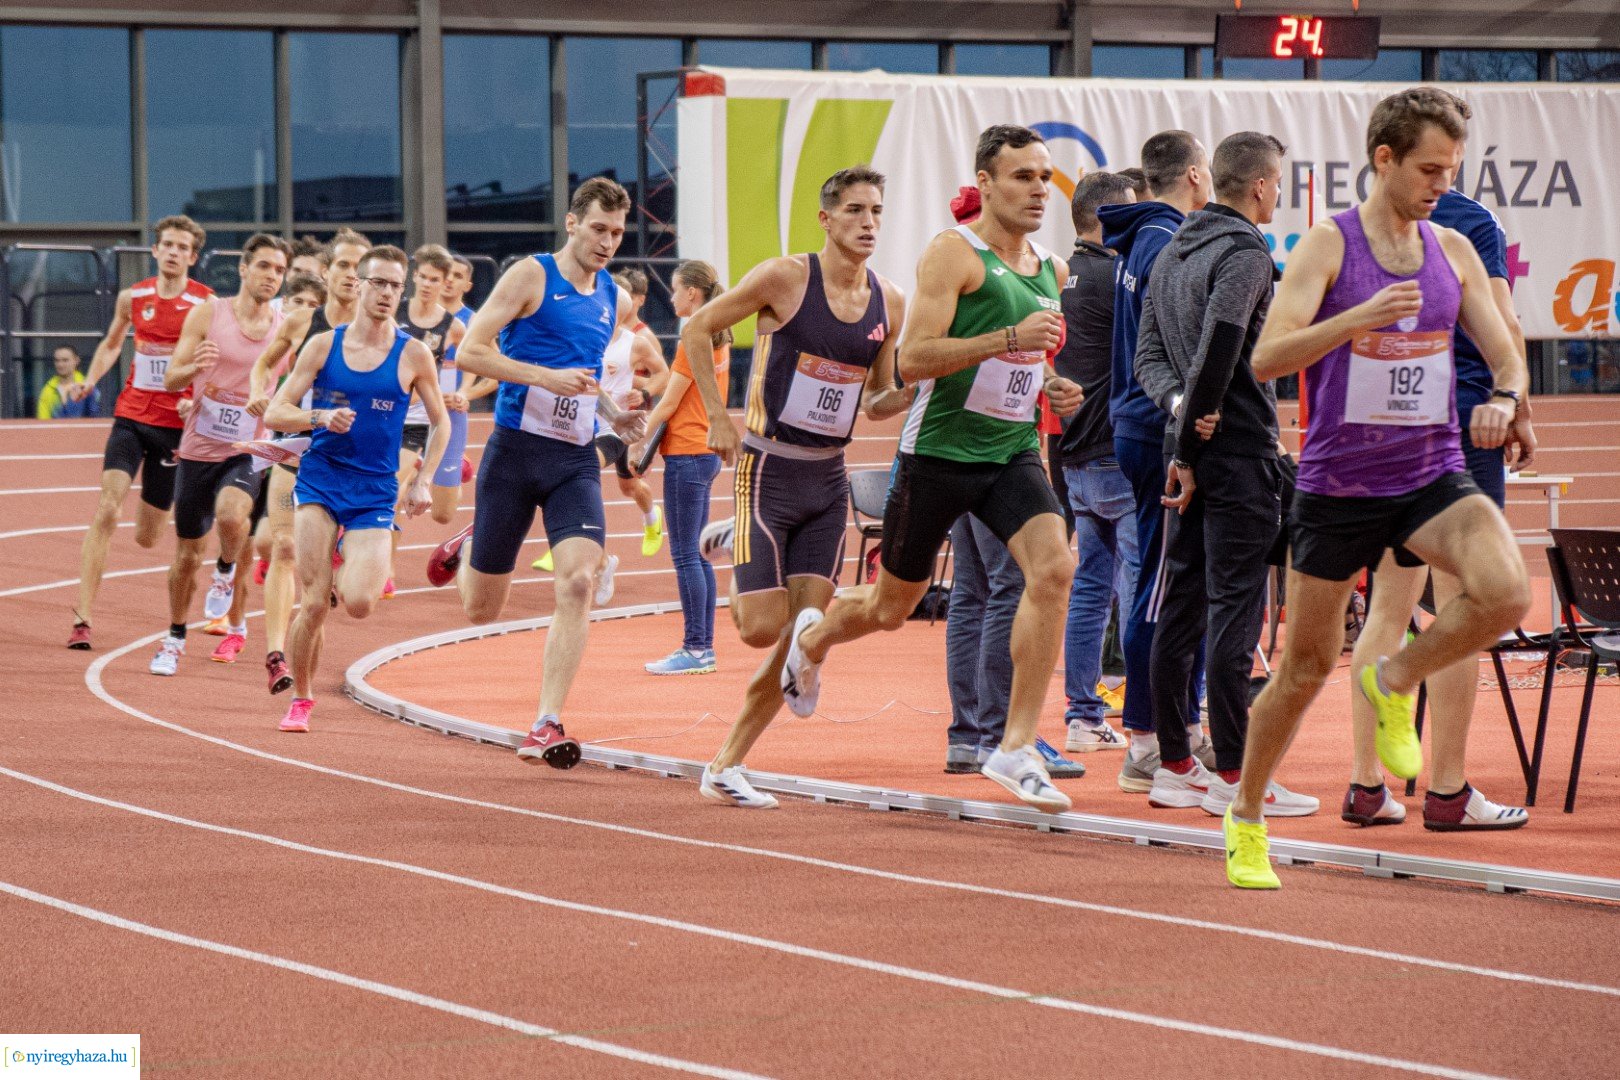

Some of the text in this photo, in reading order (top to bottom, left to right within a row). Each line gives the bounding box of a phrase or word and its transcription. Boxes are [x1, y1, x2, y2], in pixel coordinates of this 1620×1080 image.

[150, 360, 167, 374] 117
[1006, 369, 1033, 396] 180
[1389, 366, 1424, 395] 192
[371, 398, 395, 411] KSI
[553, 396, 579, 420] 193
[816, 386, 844, 412] 166
[218, 407, 242, 427] 152
[807, 411, 836, 424] PALKOVITS
